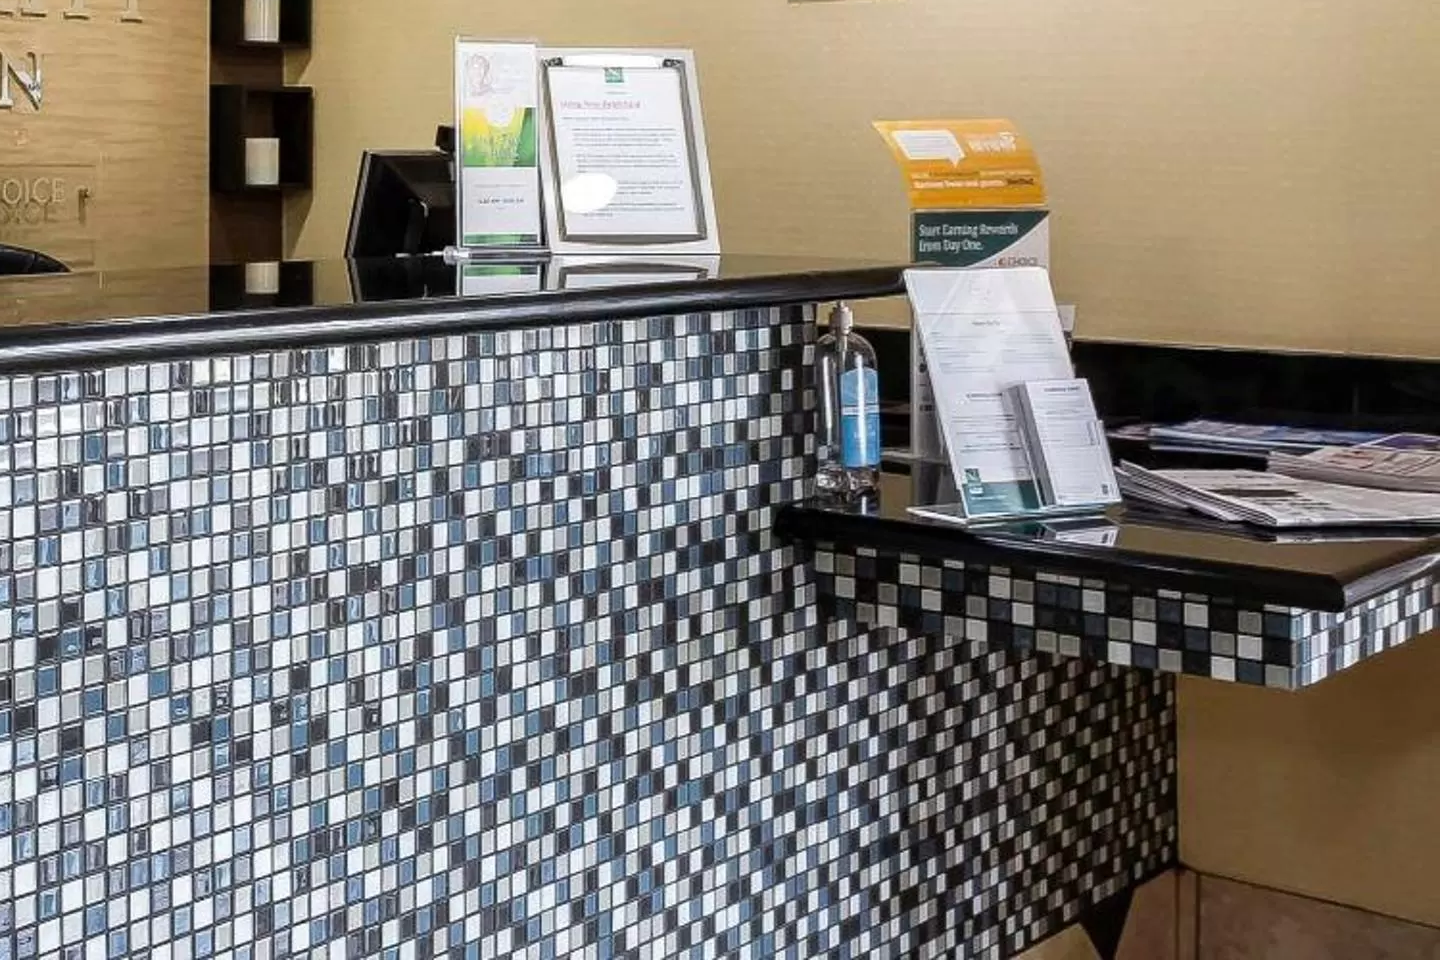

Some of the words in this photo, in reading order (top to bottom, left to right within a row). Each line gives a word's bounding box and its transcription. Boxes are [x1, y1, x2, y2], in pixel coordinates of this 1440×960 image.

[919, 224, 940, 237] Start
[942, 224, 978, 237] Earning
[979, 223, 1018, 236] Rewards
[919, 240, 941, 252] from
[944, 240, 960, 253] Day
[962, 239, 984, 251] One.
